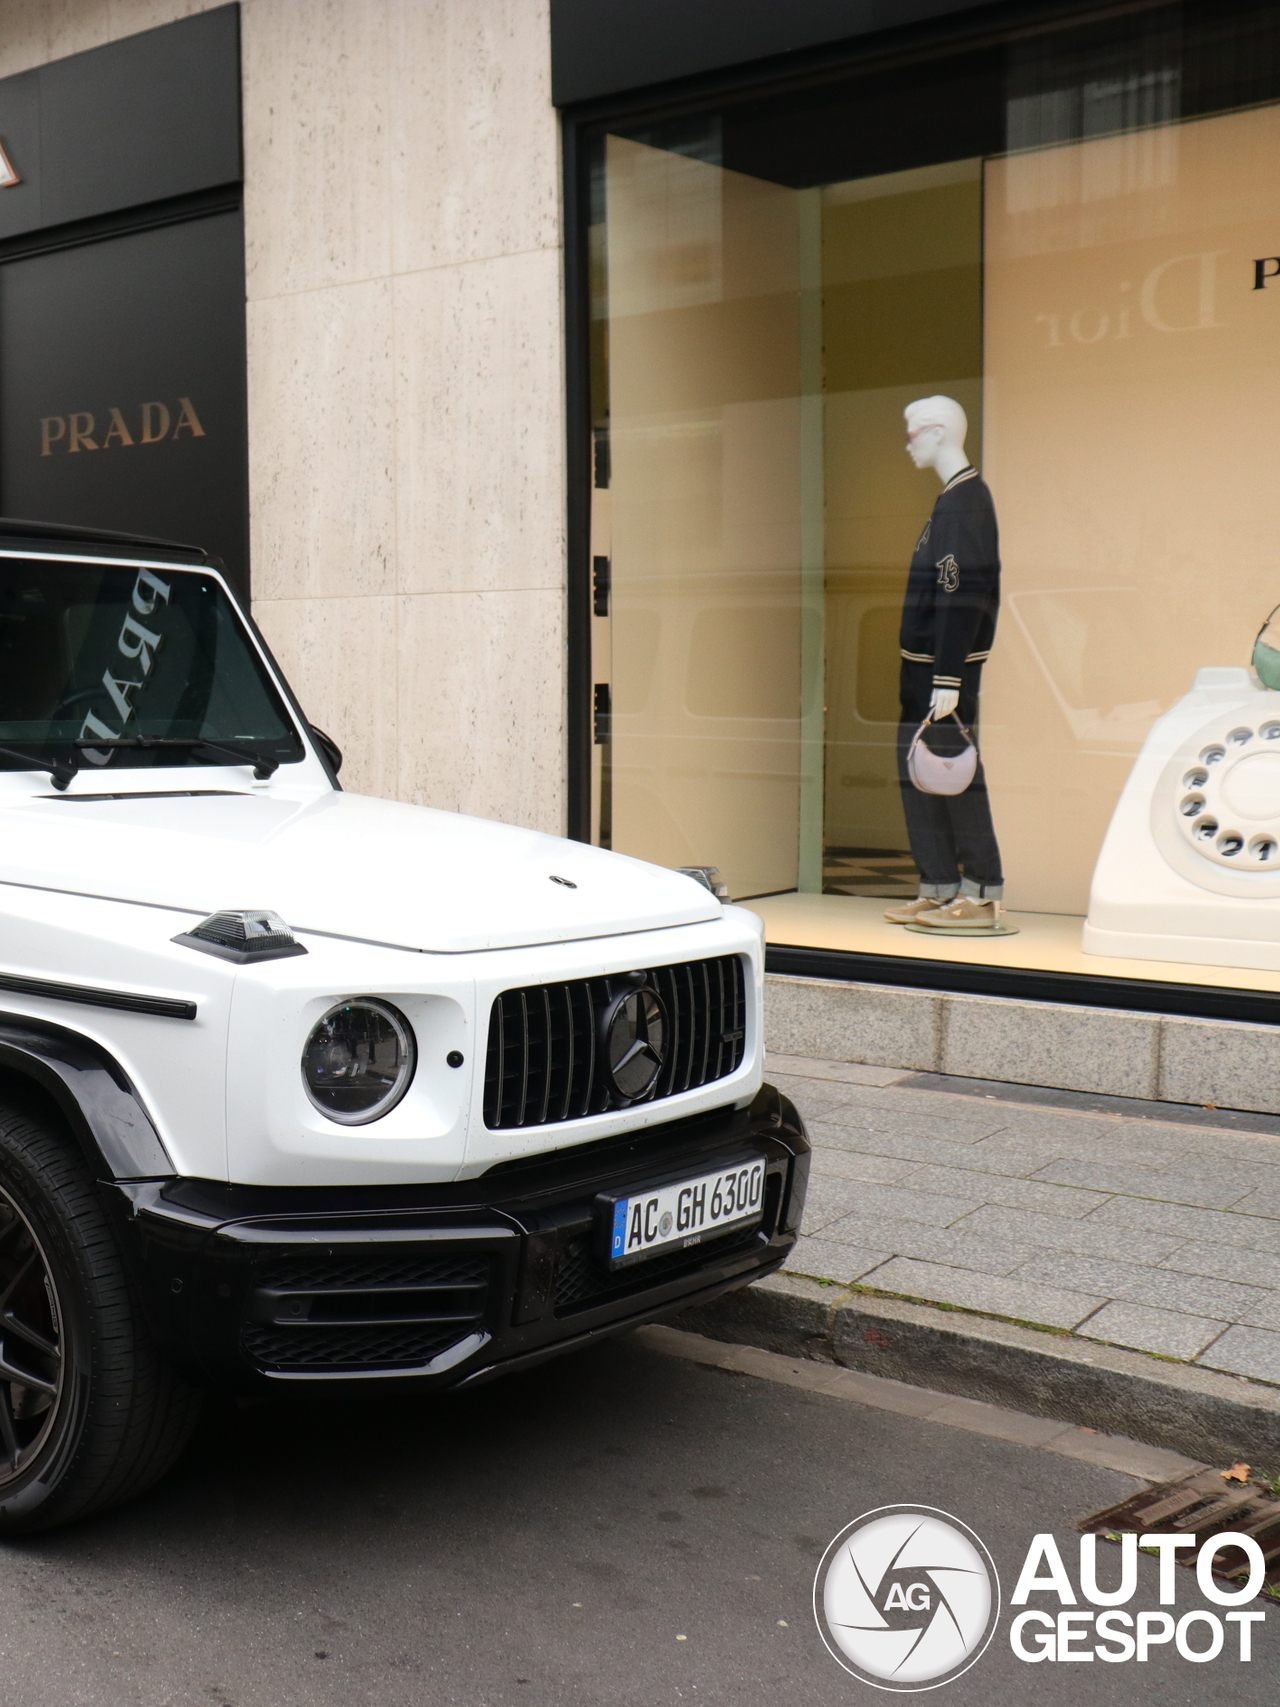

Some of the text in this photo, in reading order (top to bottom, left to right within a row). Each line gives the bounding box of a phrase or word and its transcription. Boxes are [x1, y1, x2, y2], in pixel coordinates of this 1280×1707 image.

[39, 396, 207, 456] PRADA
[935, 554, 960, 593] 13
[627, 1165, 762, 1249] AC GH 6300
[614, 1236, 621, 1249] D
